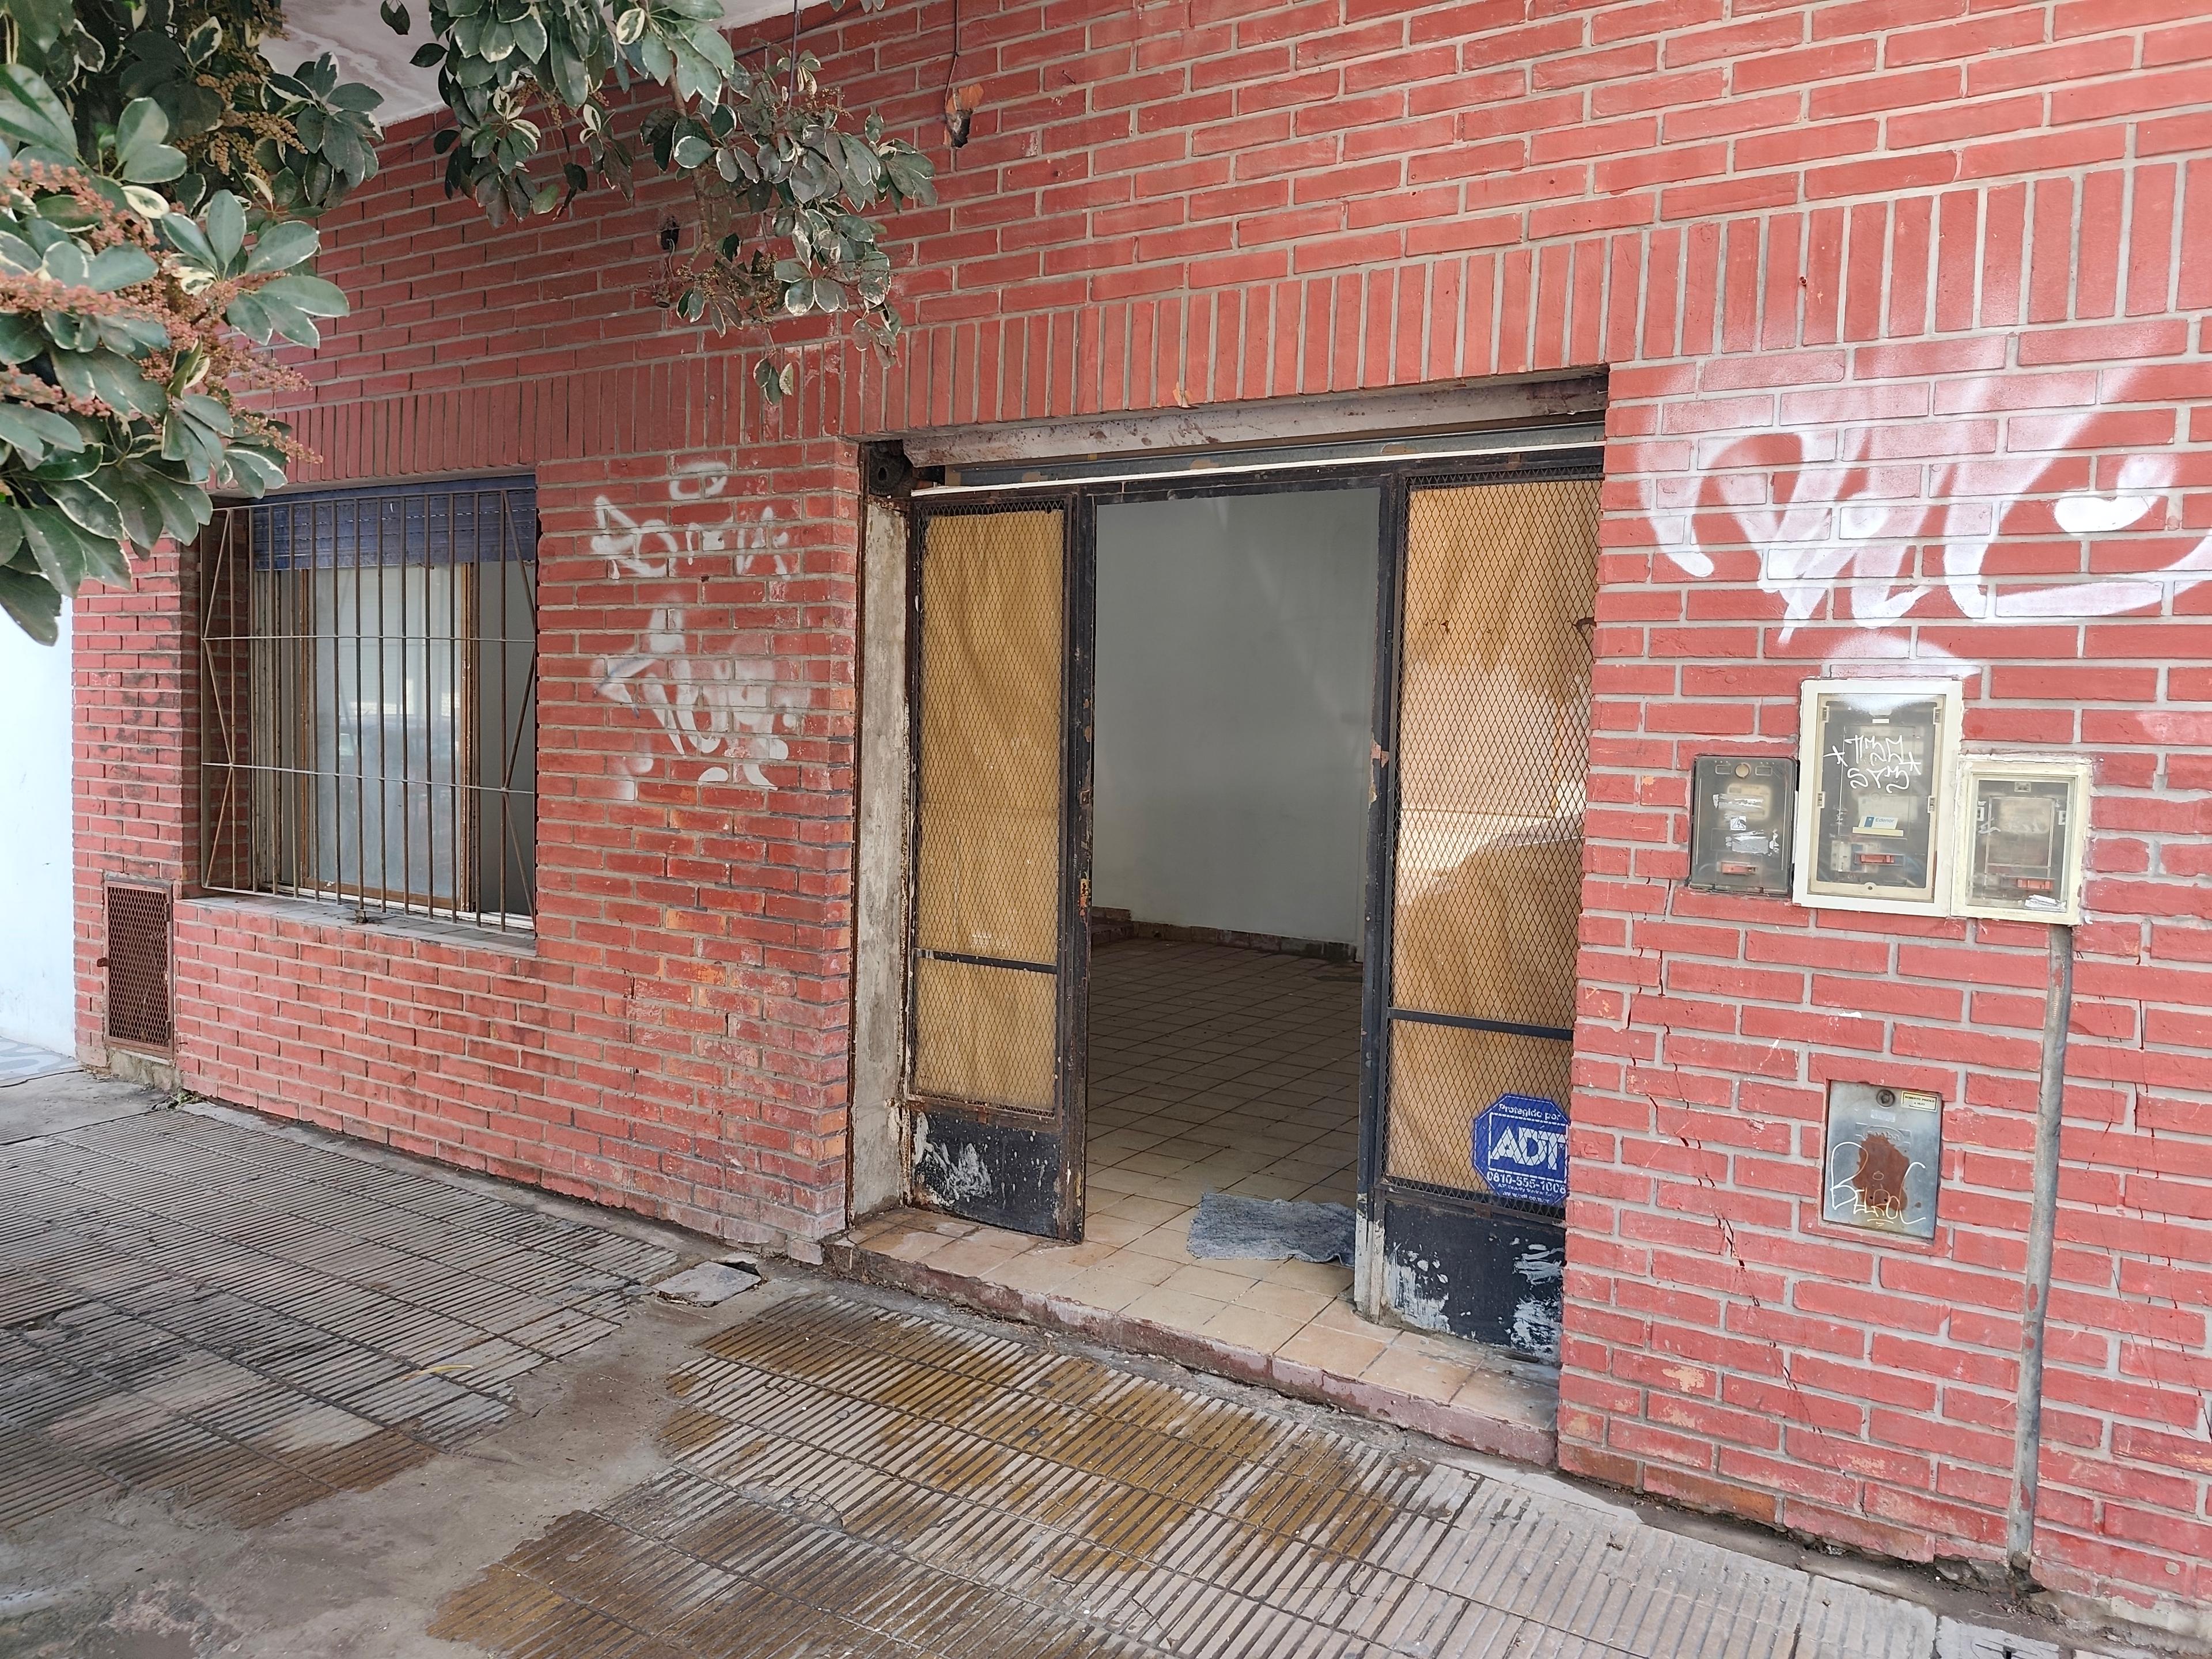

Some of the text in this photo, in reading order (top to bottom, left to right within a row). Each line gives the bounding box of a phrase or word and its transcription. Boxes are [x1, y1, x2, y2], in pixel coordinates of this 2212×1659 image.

[1499, 1103, 1561, 1121] Protegido por
[1490, 1126, 1566, 1171] ADT
[1487, 1171, 1566, 1195] 0810-555-1008
